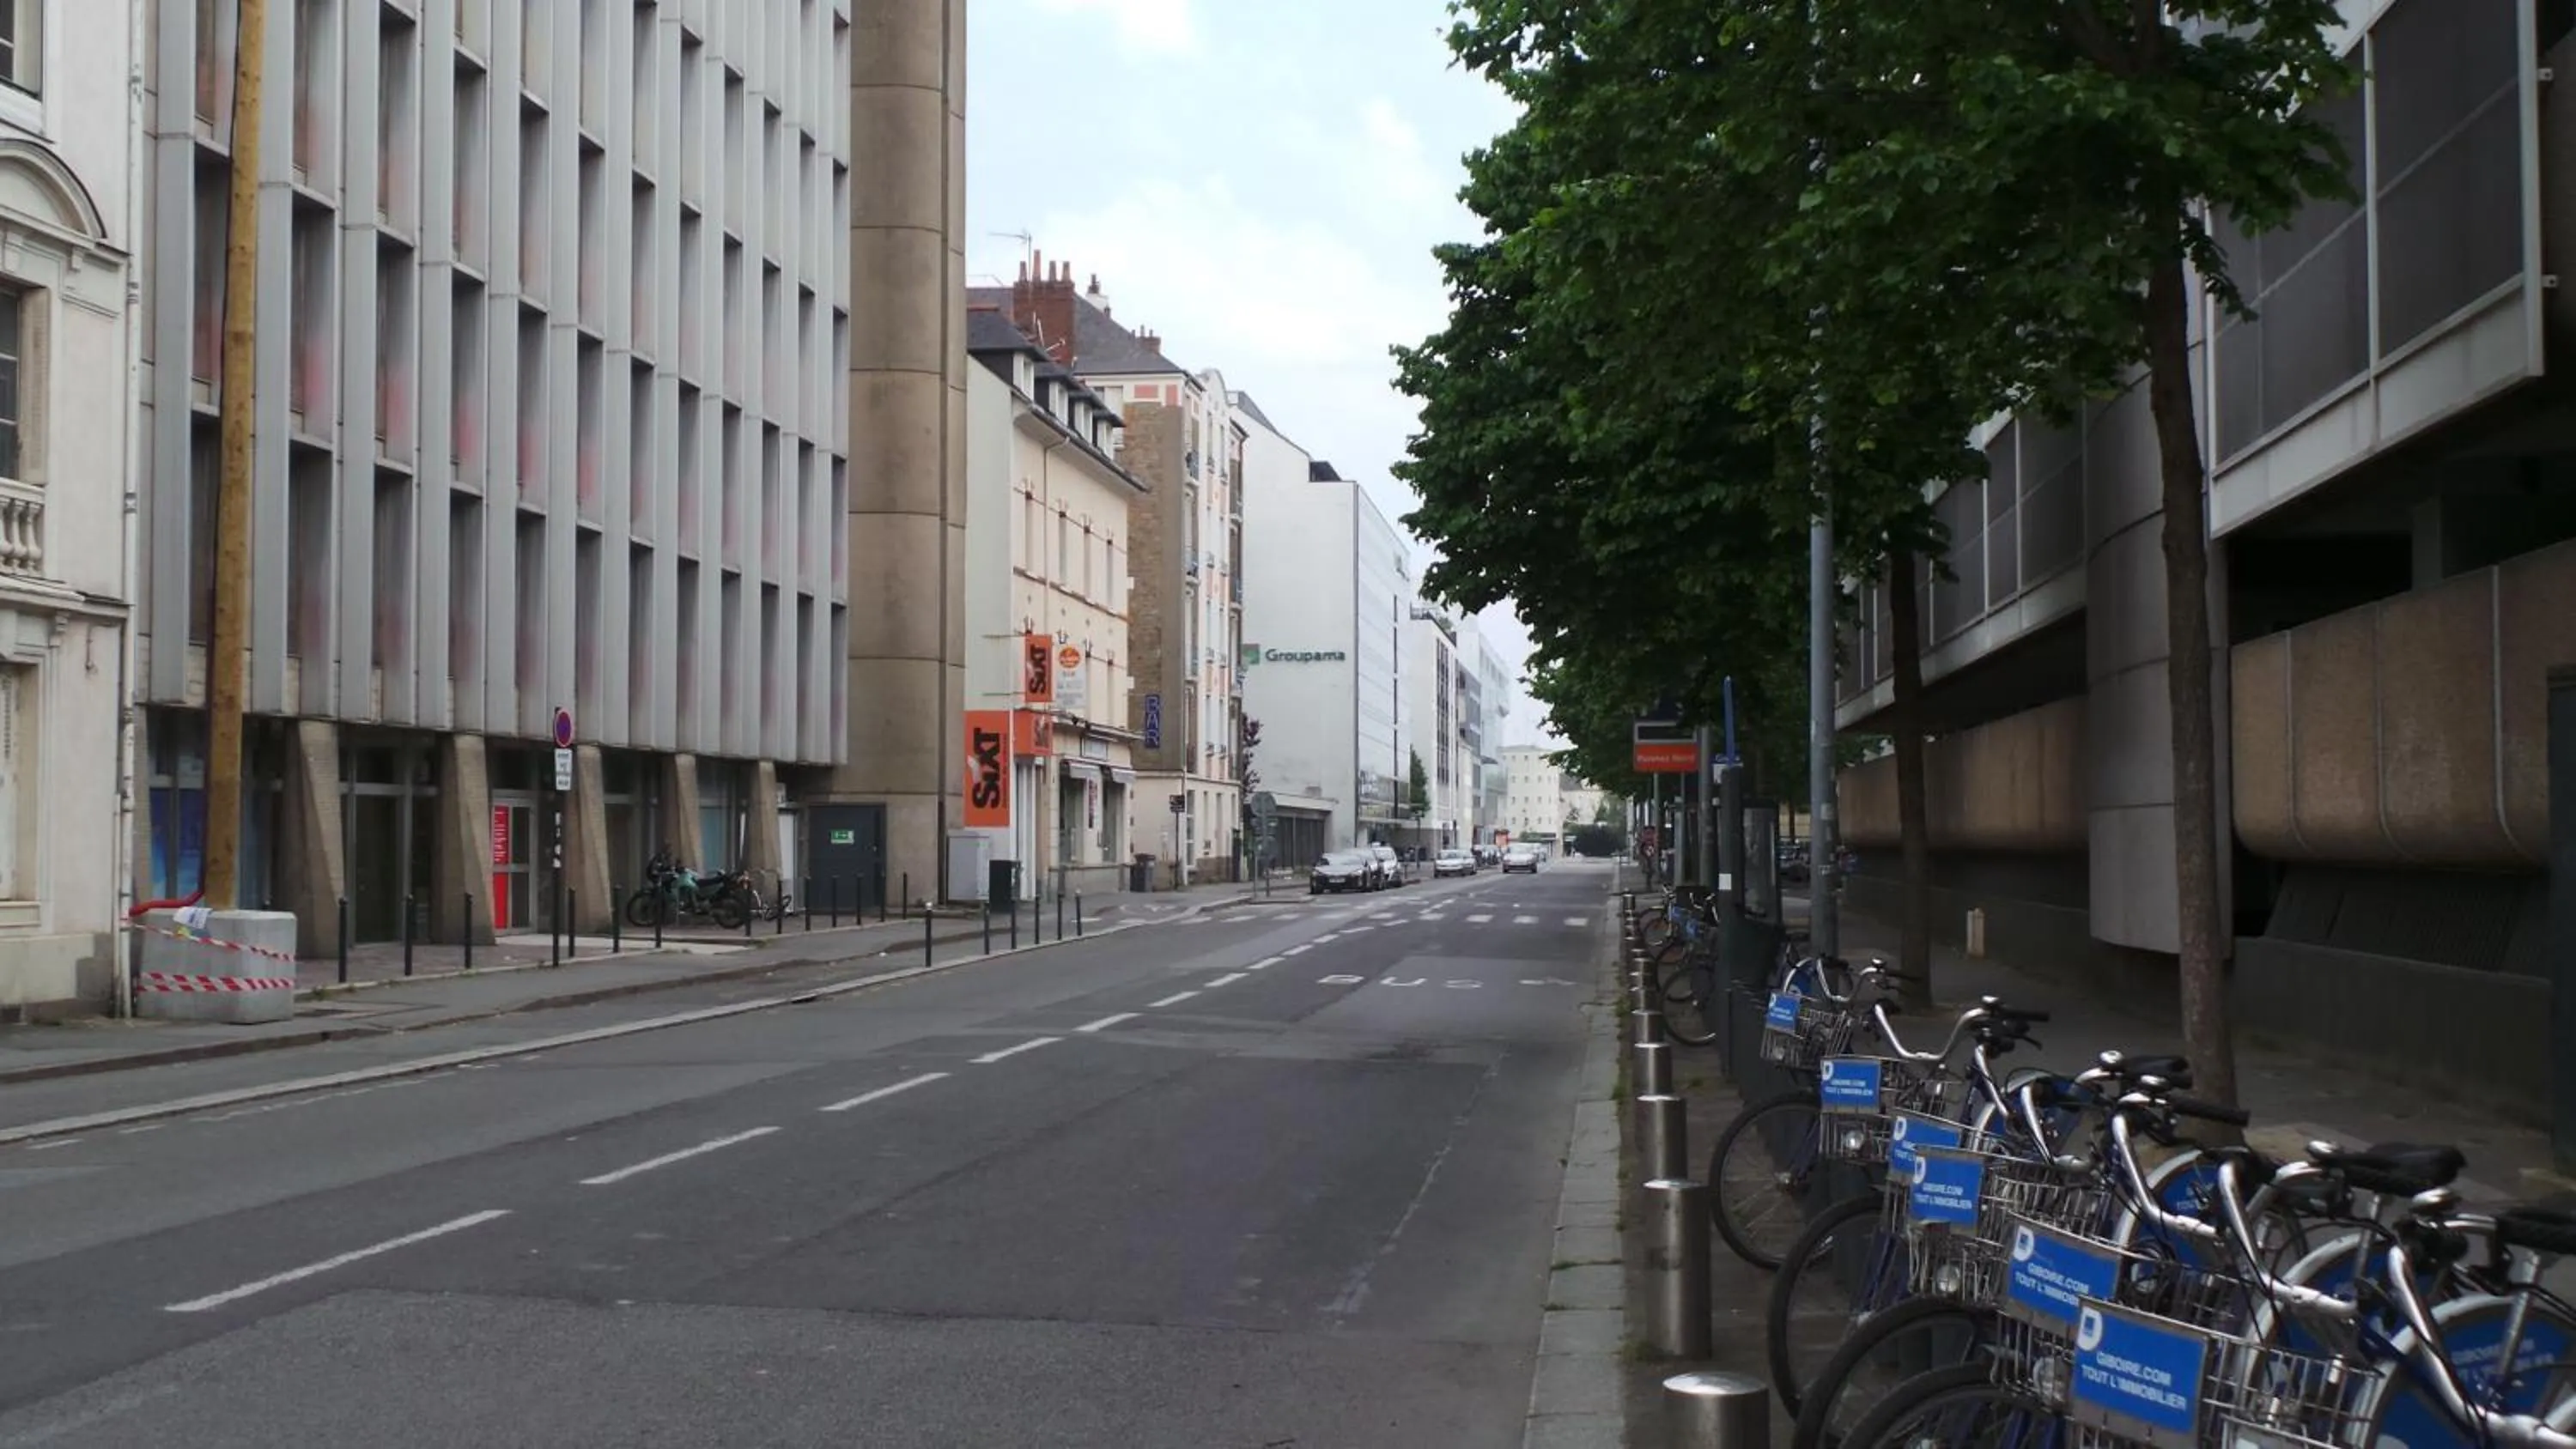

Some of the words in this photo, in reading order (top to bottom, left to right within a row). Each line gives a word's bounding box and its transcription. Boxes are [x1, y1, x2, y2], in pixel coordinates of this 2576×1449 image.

[1265, 649, 1346, 664] Groupama
[1145, 696, 1158, 745] BAR
[2014, 1270, 2037, 1289] TOUT
[2081, 1363, 2109, 1385] TOUT
[2095, 1350, 2172, 1386] GIBOIRE.COM
